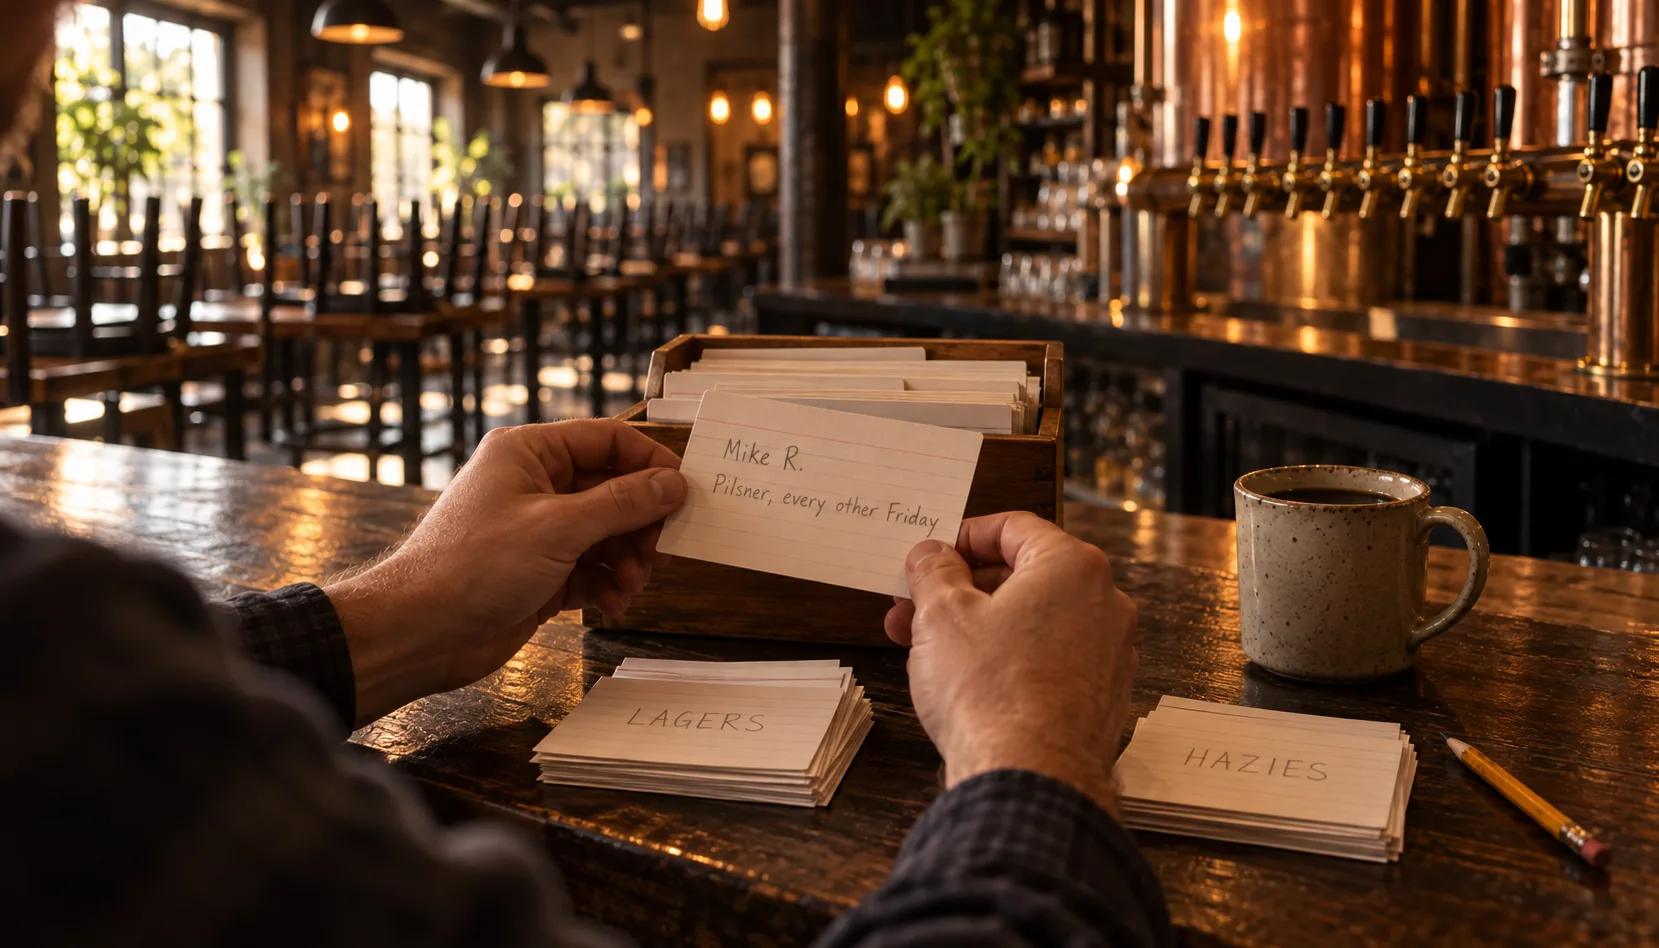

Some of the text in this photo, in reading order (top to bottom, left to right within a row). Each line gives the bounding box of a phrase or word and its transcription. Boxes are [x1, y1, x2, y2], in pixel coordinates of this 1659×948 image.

[722, 437, 804, 472] Mike R.
[712, 473, 940, 538] Pilsner, every other Friday
[626, 707, 766, 733] LAGERS
[1183, 747, 1329, 782] HAZIES
